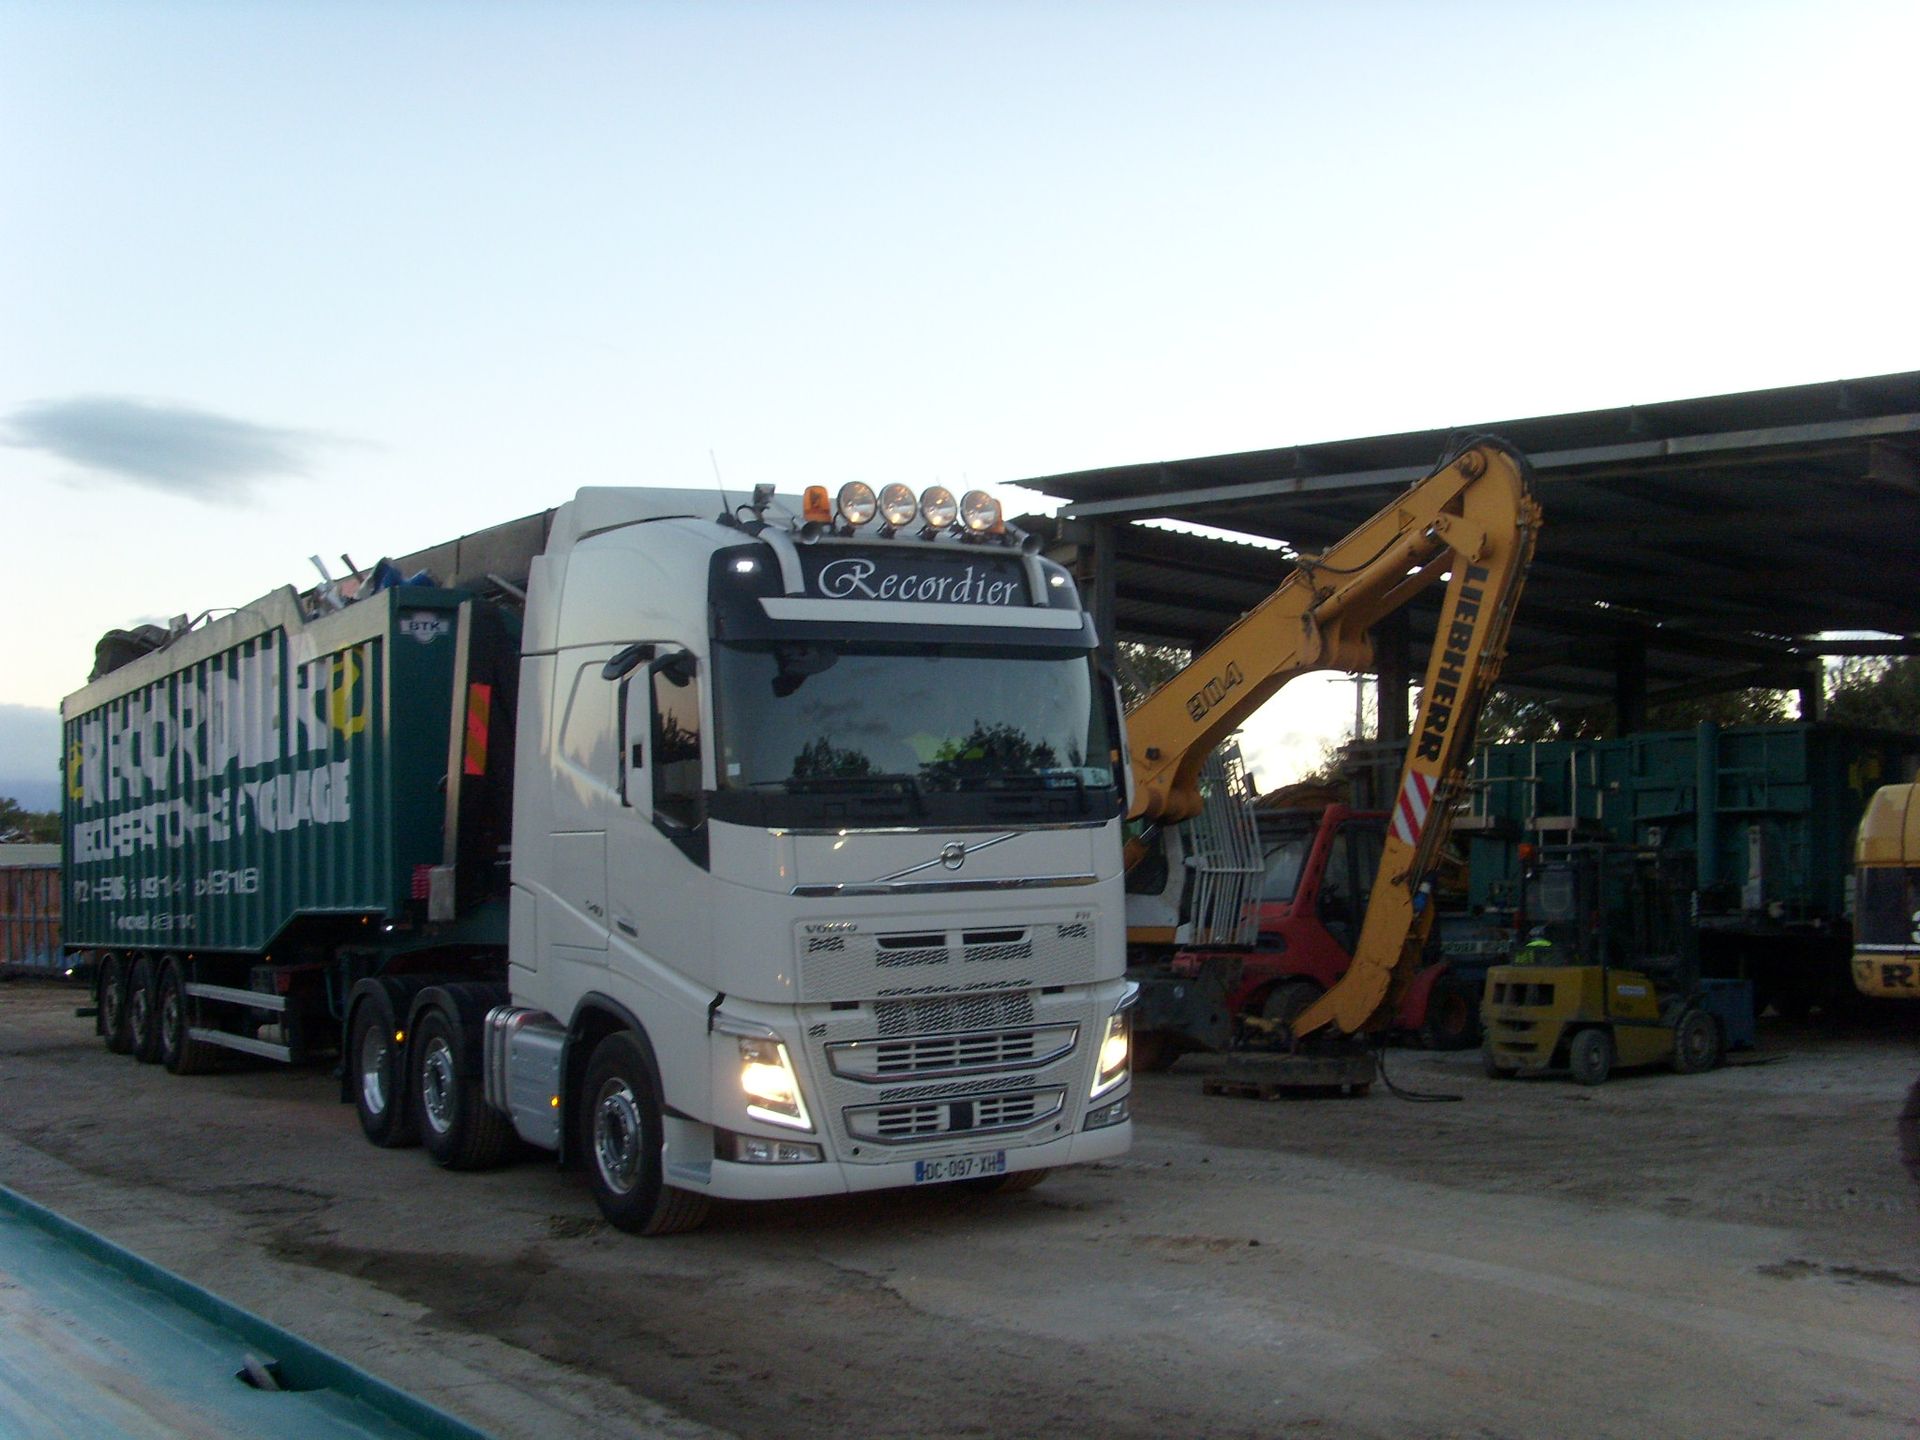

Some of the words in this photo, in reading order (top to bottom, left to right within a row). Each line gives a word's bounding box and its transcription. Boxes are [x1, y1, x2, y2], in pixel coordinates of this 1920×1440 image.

[817, 558, 1018, 605] Recordier
[1185, 660, 1245, 722] 904
[1415, 565, 1490, 763] LIEBHERR
[804, 922, 858, 934] VOLVO
